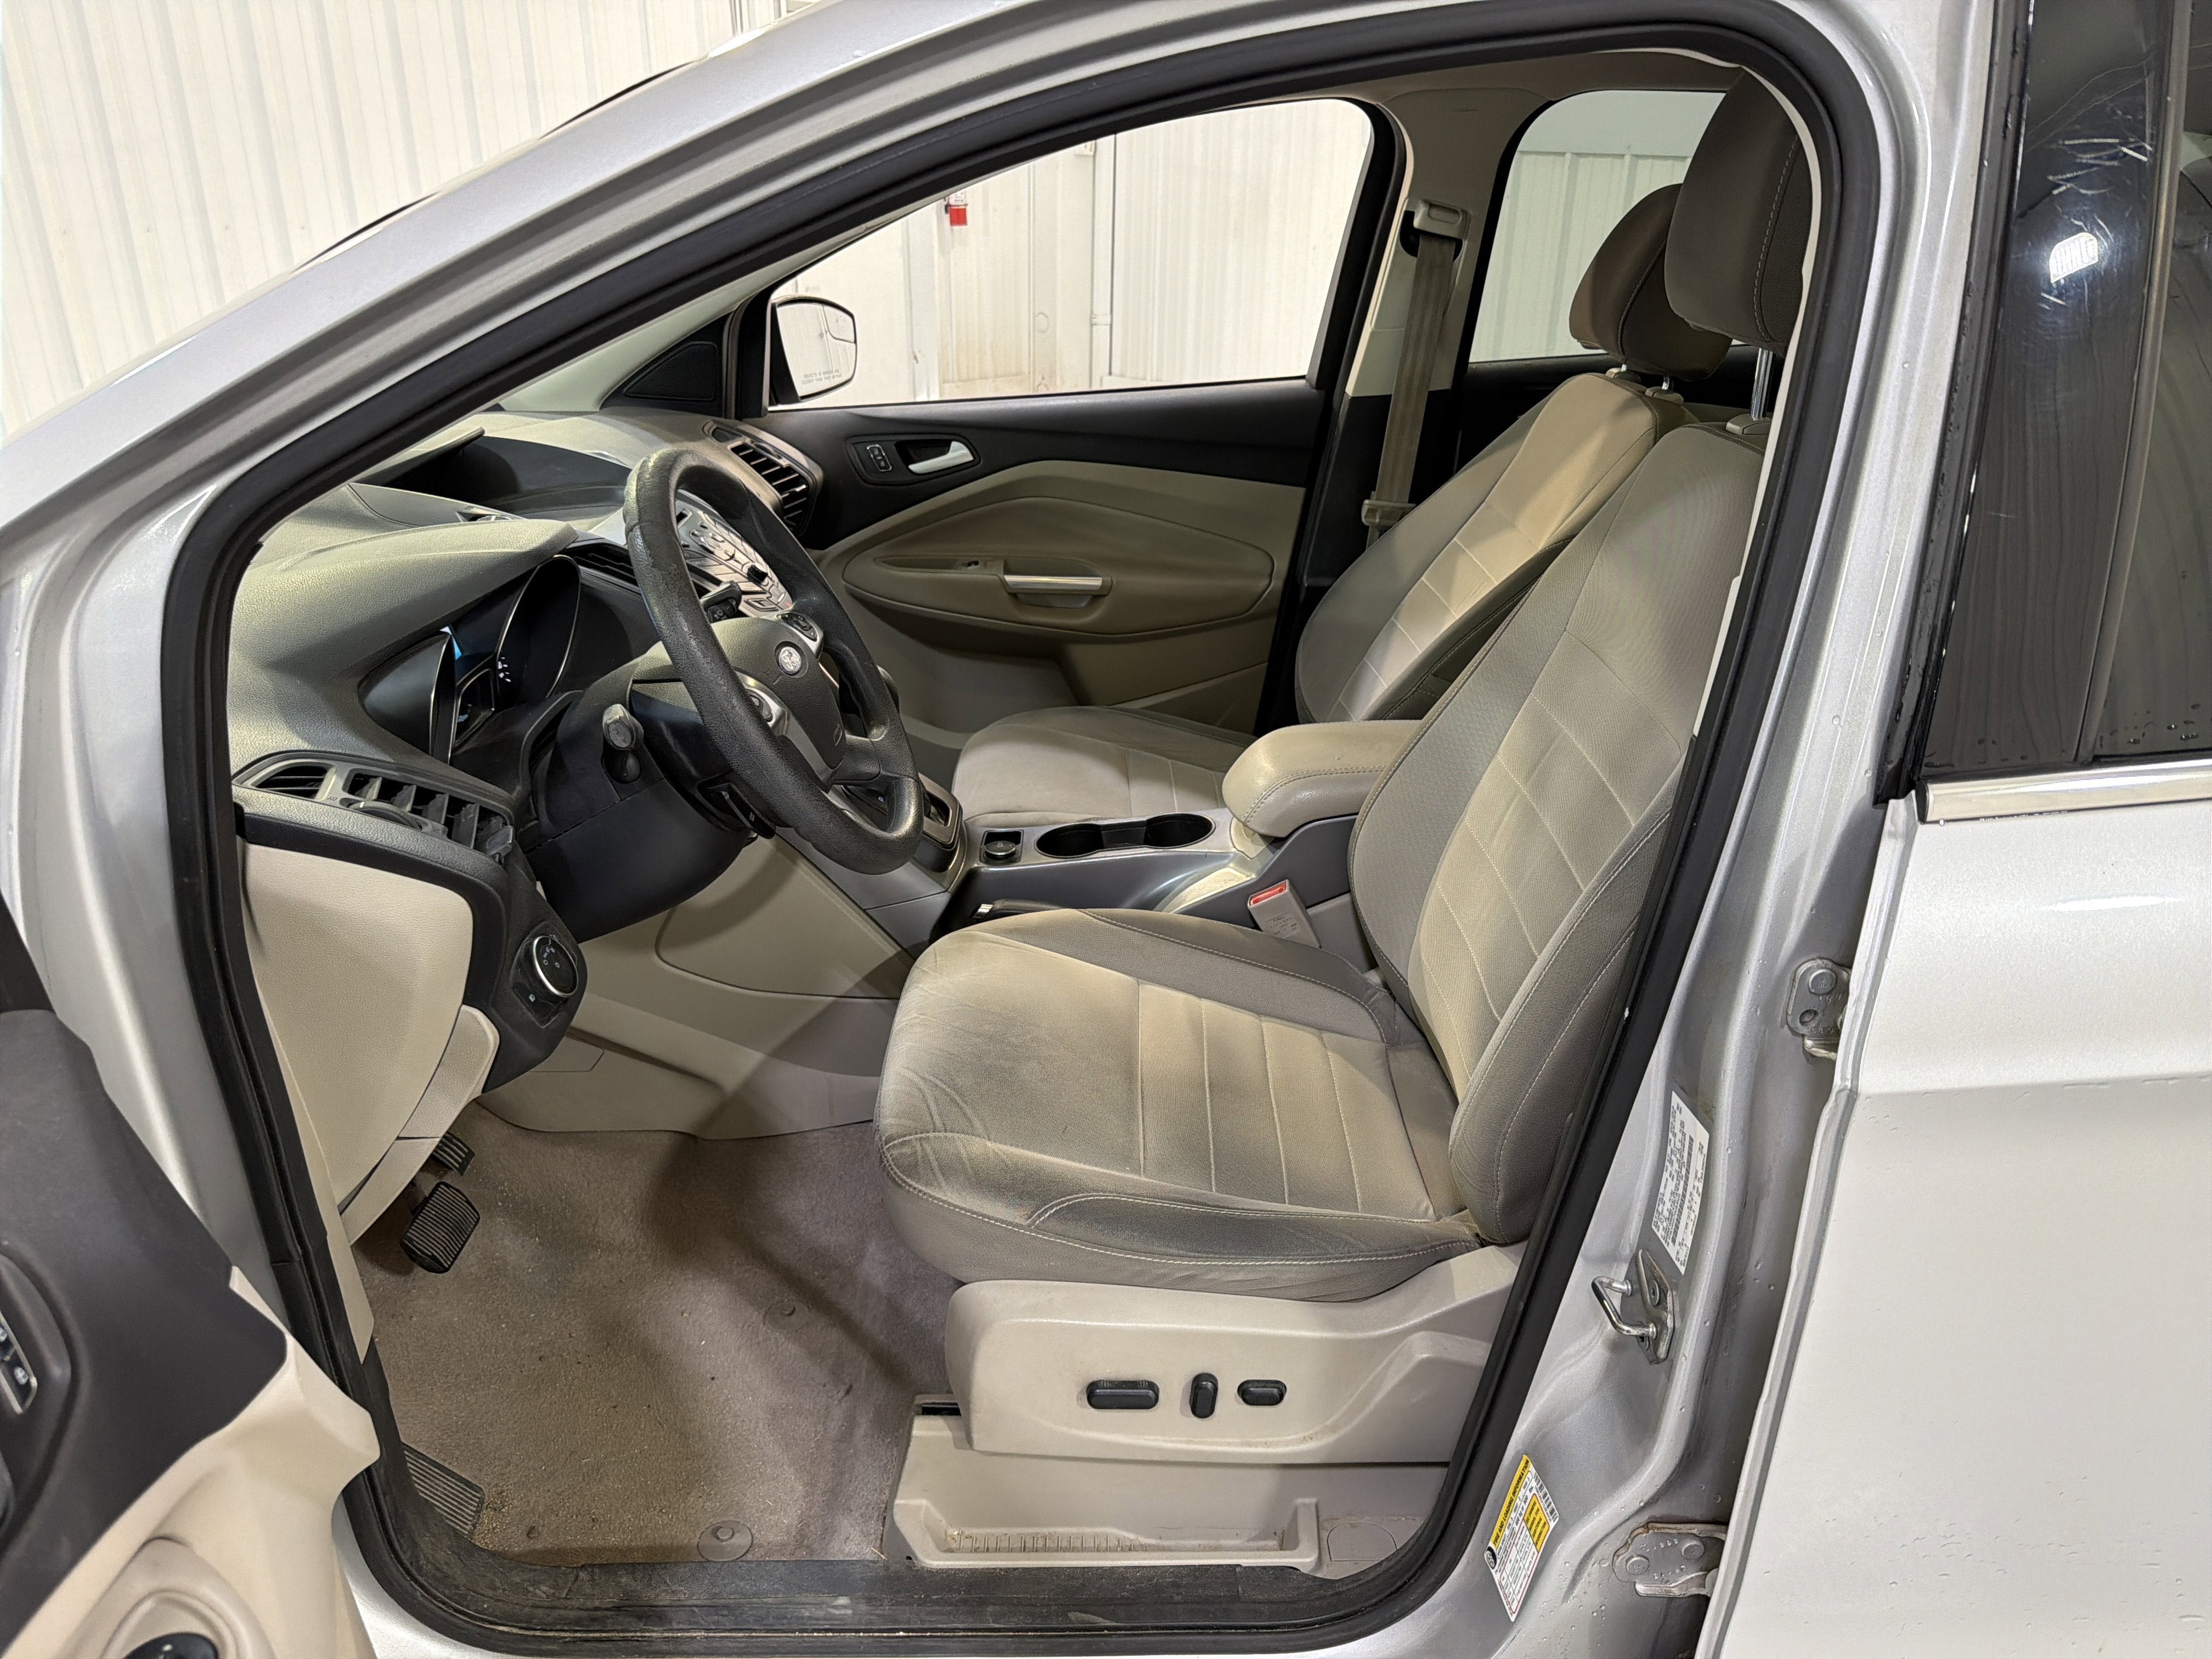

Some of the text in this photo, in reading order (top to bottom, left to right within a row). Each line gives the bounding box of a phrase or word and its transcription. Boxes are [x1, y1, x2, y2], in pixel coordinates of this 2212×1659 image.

[781, 650, 801, 669] Ford
[1503, 1496, 1514, 1521] LOADING
[1511, 1458, 1530, 1497] INFORMATION
